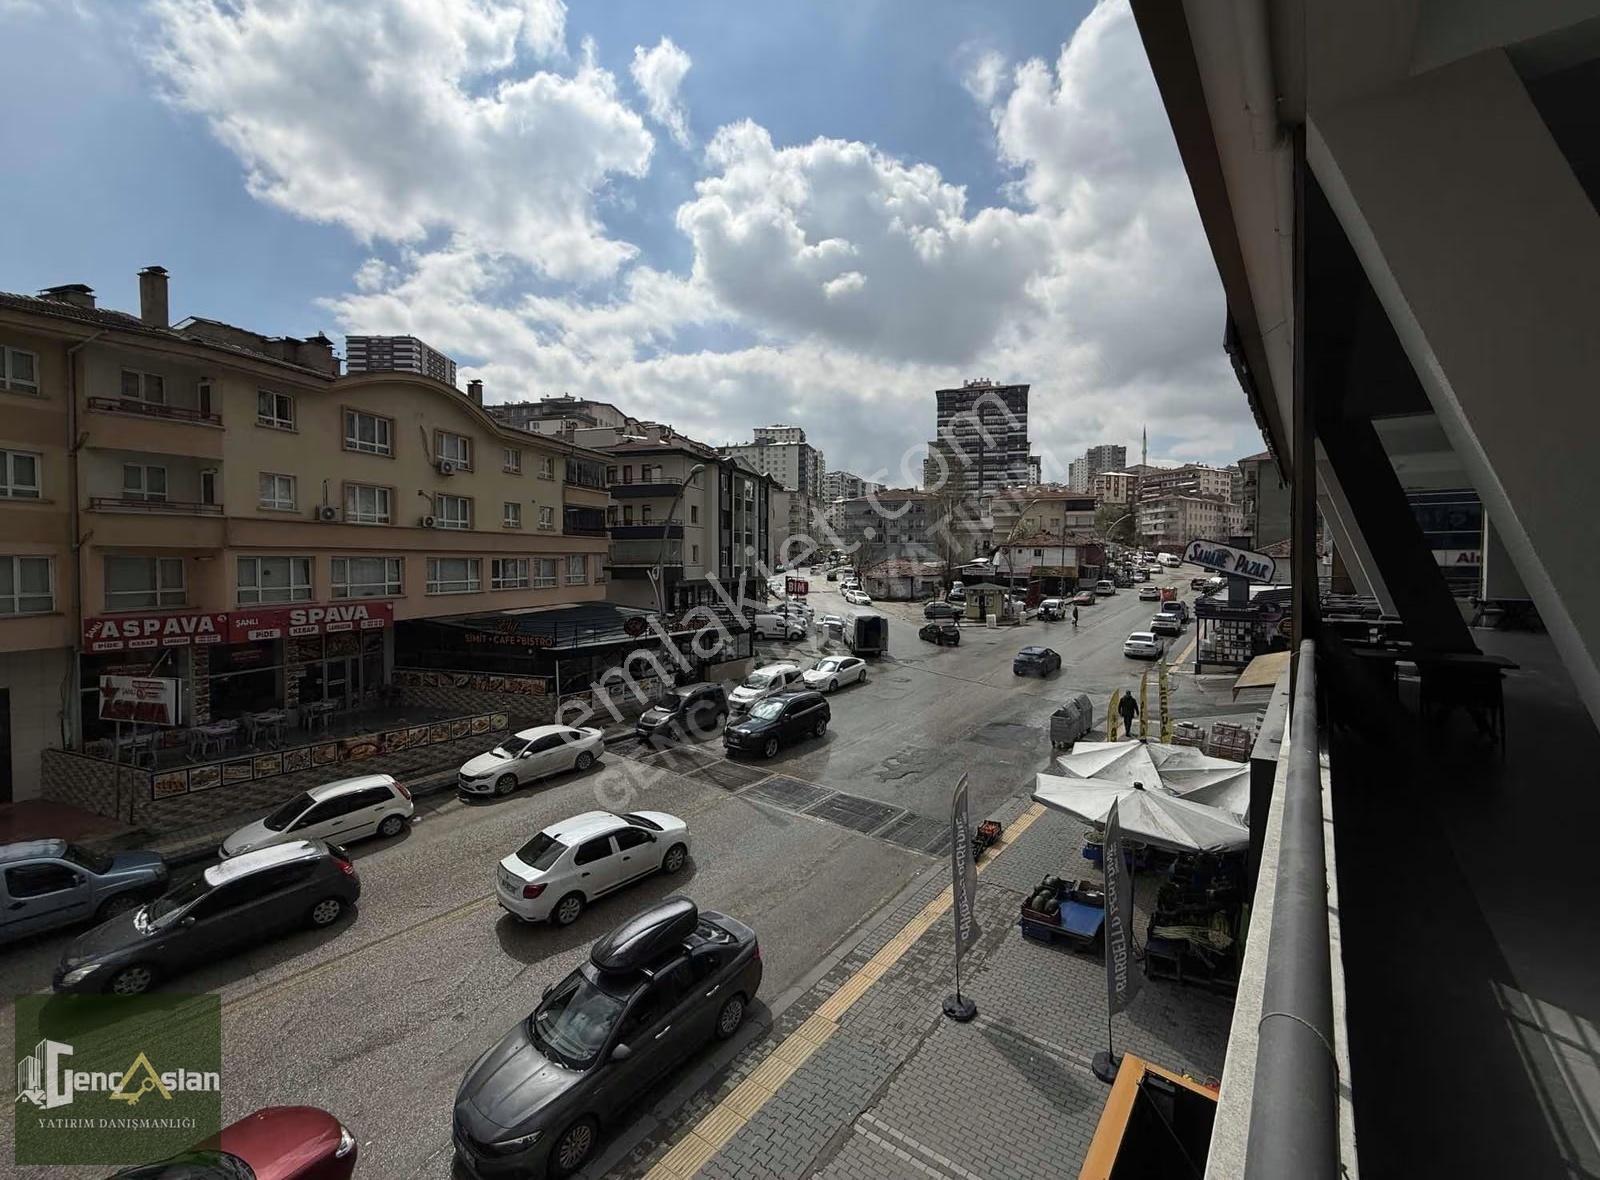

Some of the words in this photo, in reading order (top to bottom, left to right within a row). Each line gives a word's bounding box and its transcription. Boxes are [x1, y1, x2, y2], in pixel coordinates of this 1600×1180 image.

[1234, 554, 1270, 579] PAZAR
[289, 605, 369, 626] SPAVA
[99, 616, 215, 639] ASPAVA
[493, 634, 516, 645] CAFE
[1111, 916, 1128, 993] BARGELLO
